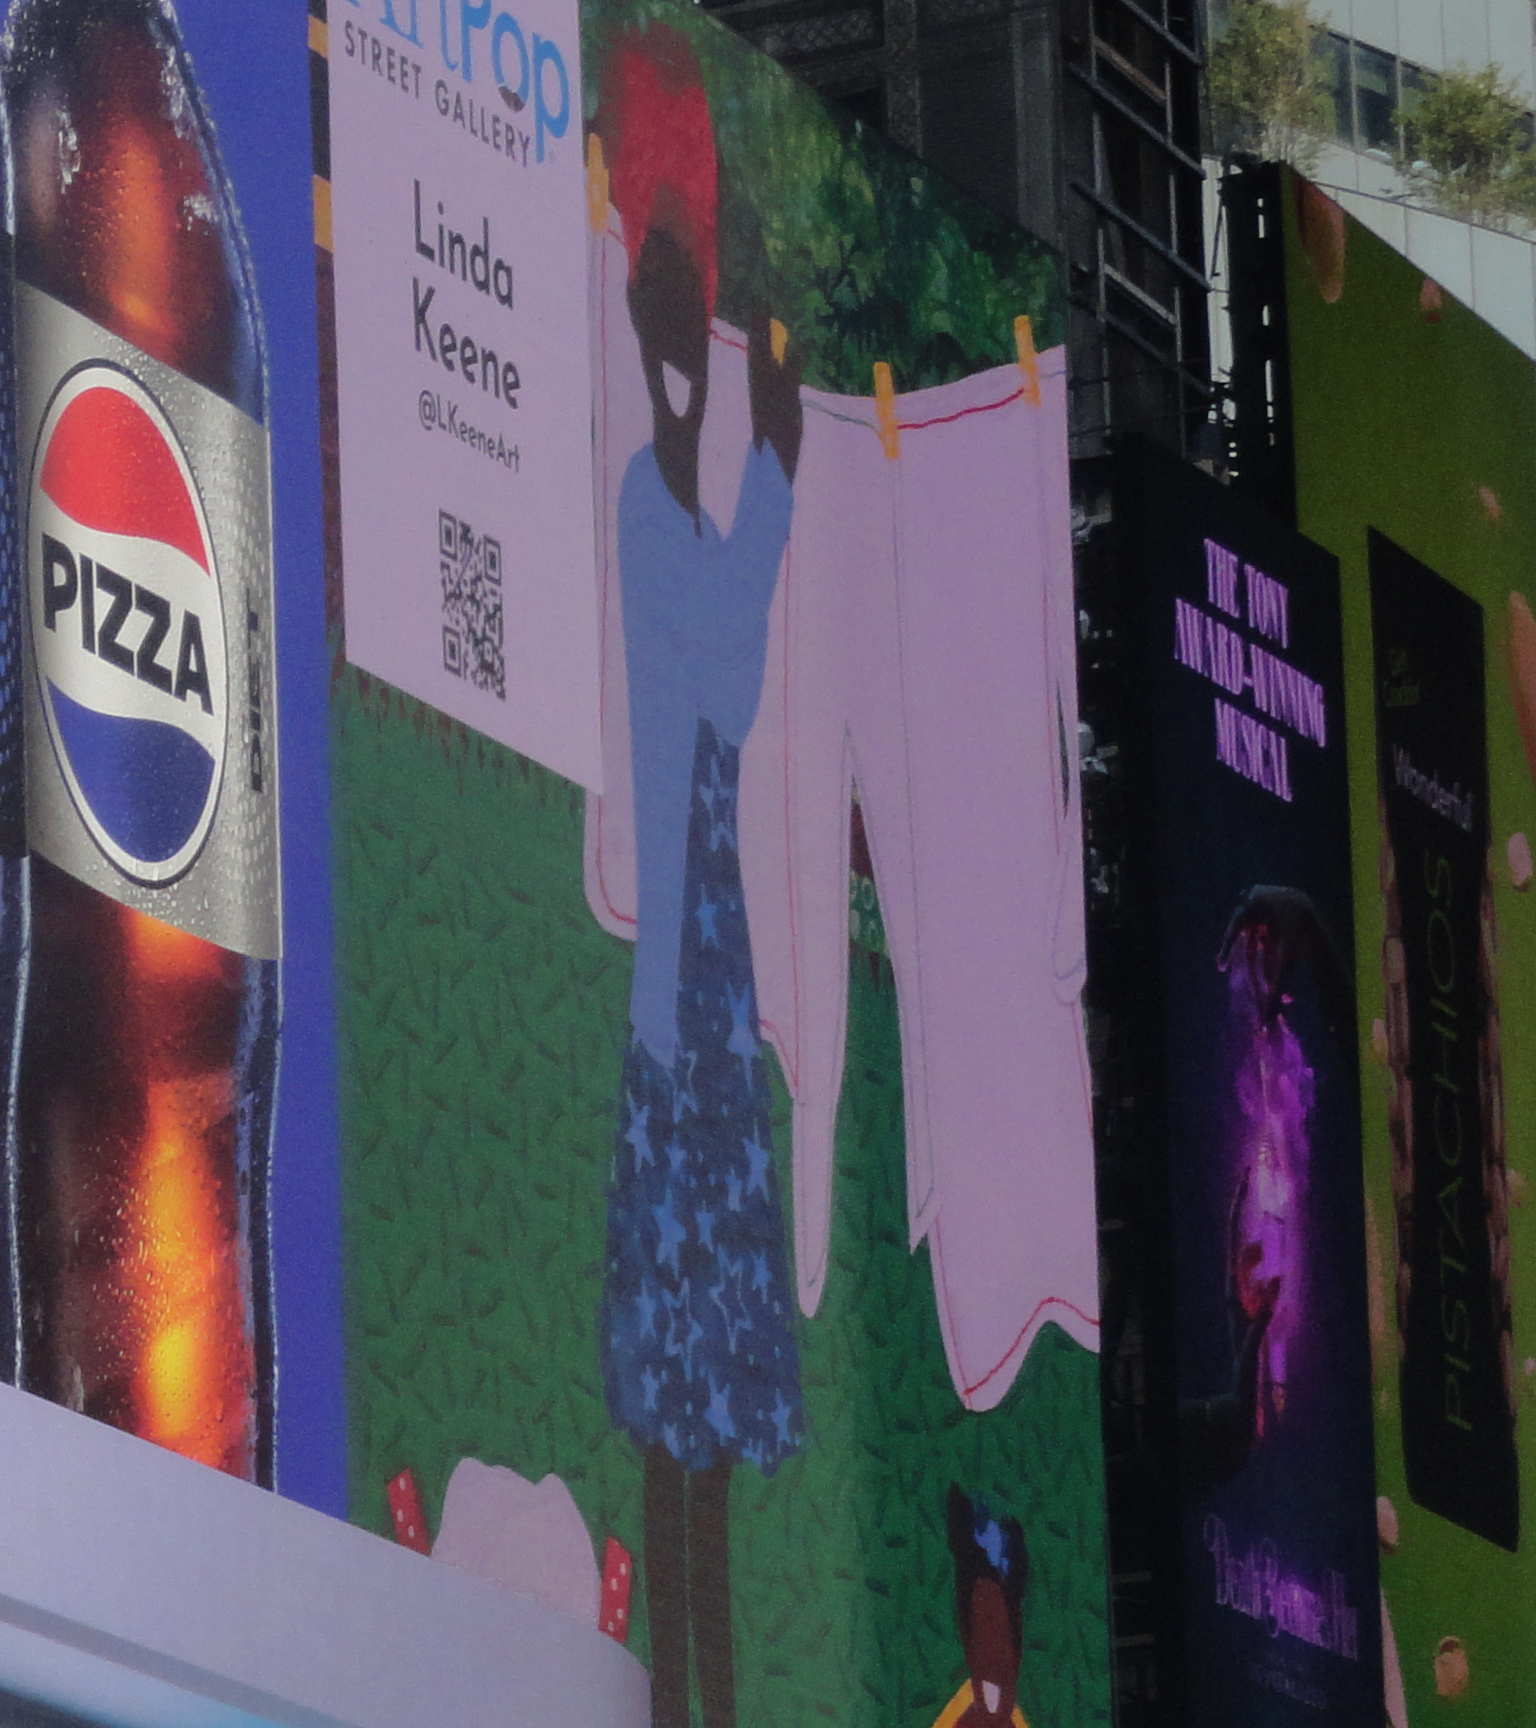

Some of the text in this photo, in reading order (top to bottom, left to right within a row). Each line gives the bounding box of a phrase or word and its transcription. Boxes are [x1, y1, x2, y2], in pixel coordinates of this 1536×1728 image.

[344, 19, 530, 167] STREET GALLERY
[413, 178, 514, 310] Linda
[412, 276, 521, 410] Keene
[417, 388, 520, 473] @LKeeneArt
[41, 532, 214, 717] PIZZA
[1424, 849, 1473, 1432] PISTACHIOS
